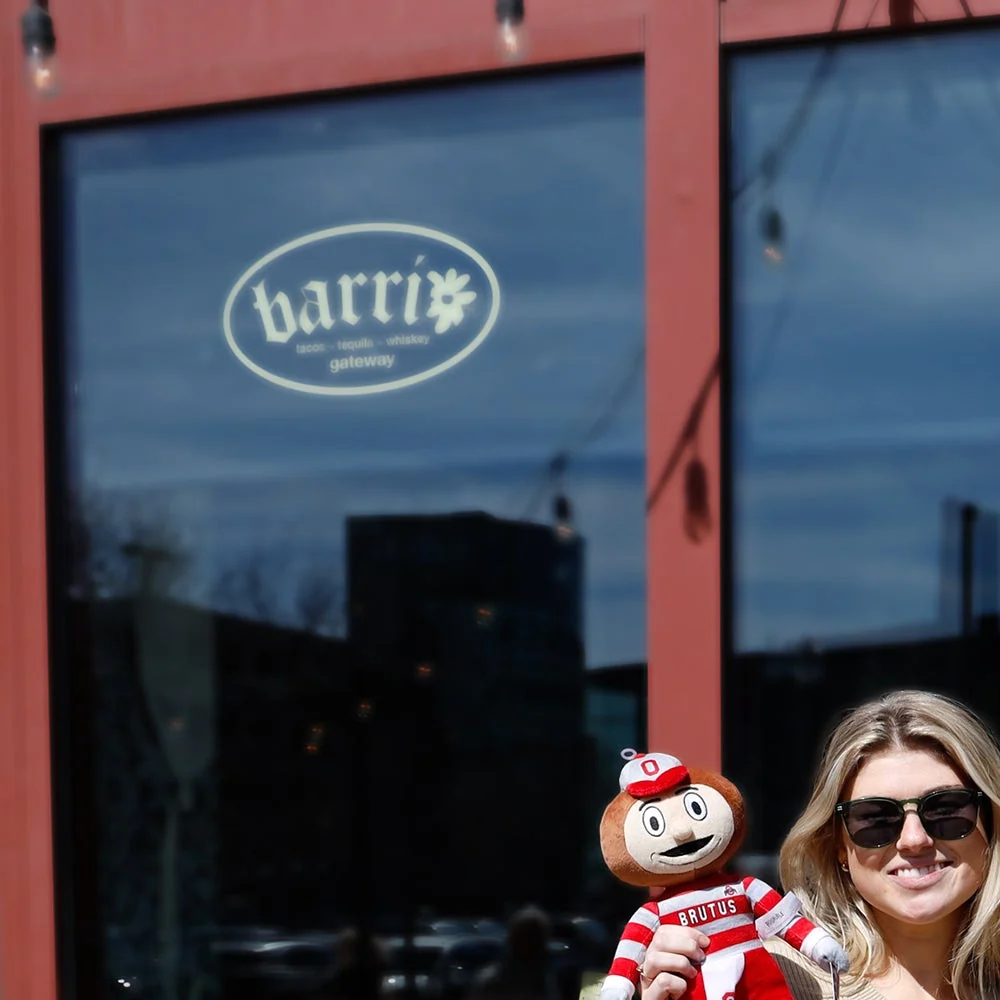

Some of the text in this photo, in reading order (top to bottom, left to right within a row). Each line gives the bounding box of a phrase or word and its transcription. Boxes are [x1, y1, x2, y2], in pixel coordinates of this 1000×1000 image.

[385, 333, 430, 347] whiskey
[330, 353, 395, 374] gateway
[639, 758, 660, 777] O
[678, 899, 738, 927] BRUTUS
